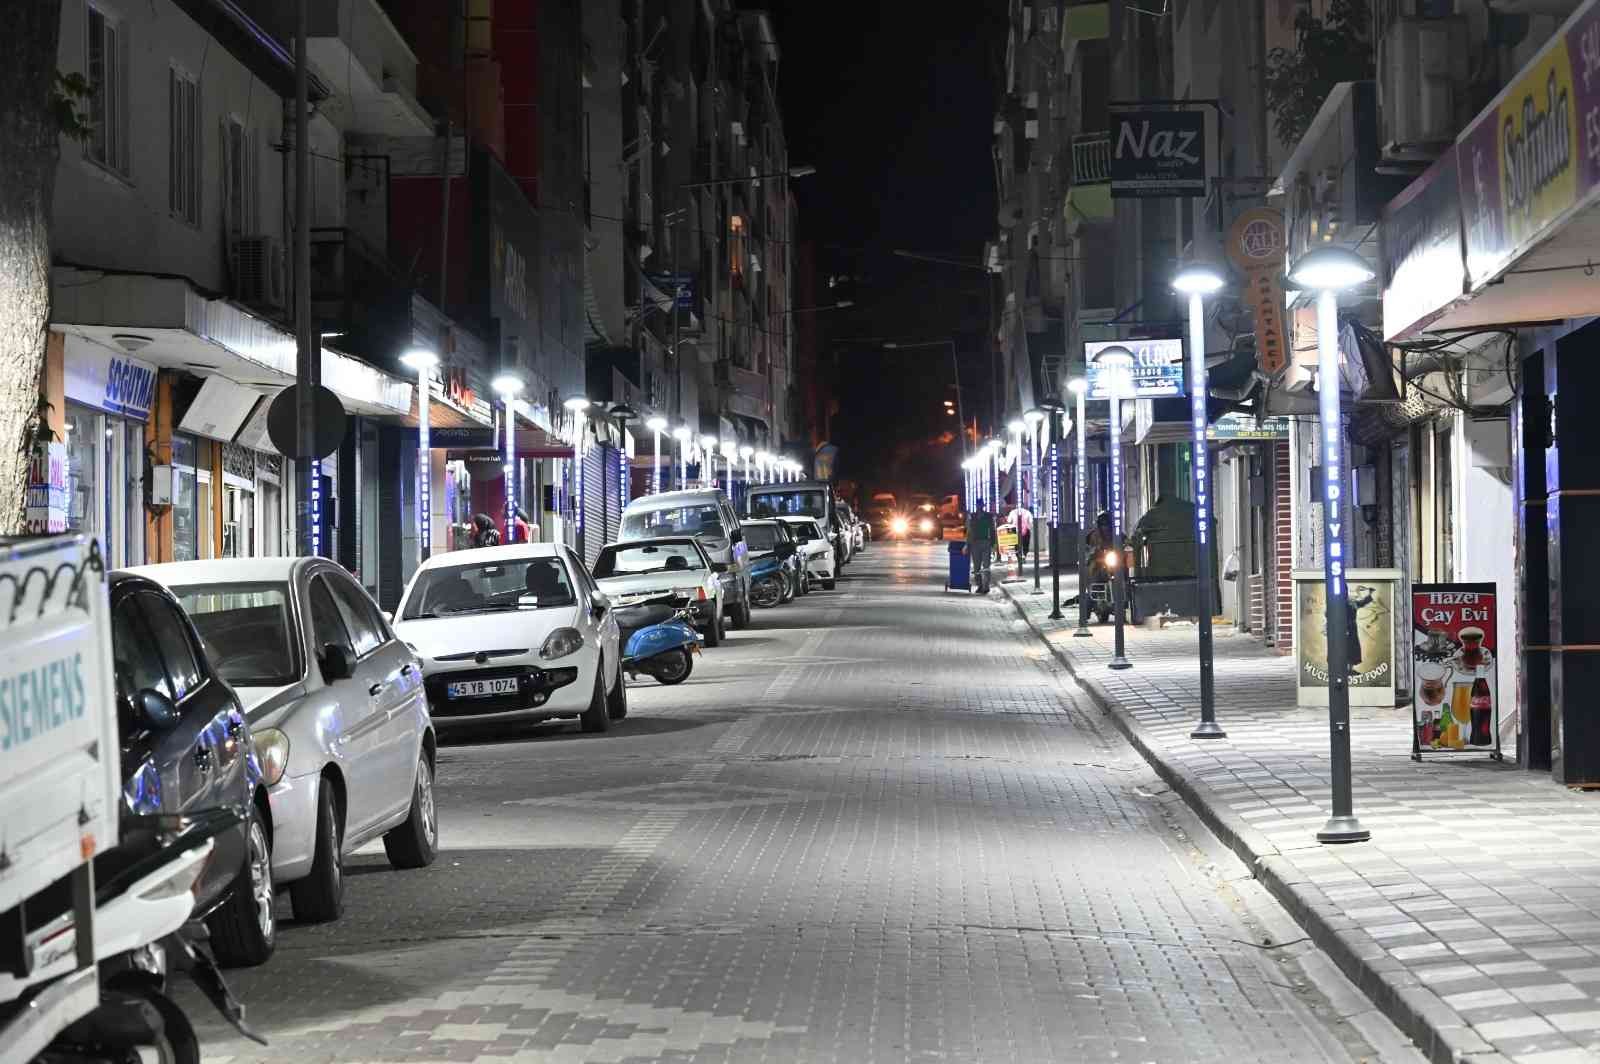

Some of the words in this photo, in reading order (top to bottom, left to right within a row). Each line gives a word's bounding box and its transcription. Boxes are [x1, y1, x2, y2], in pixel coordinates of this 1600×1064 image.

[1115, 120, 1200, 165] Naz
[1421, 608, 1455, 625] Çay
[1461, 606, 1489, 621] Evi
[1365, 662, 1389, 681] FOOD
[454, 683, 467, 696] 45
[471, 681, 484, 693] YB
[489, 679, 516, 692] 1074
[0, 653, 86, 750] SIEMENS
